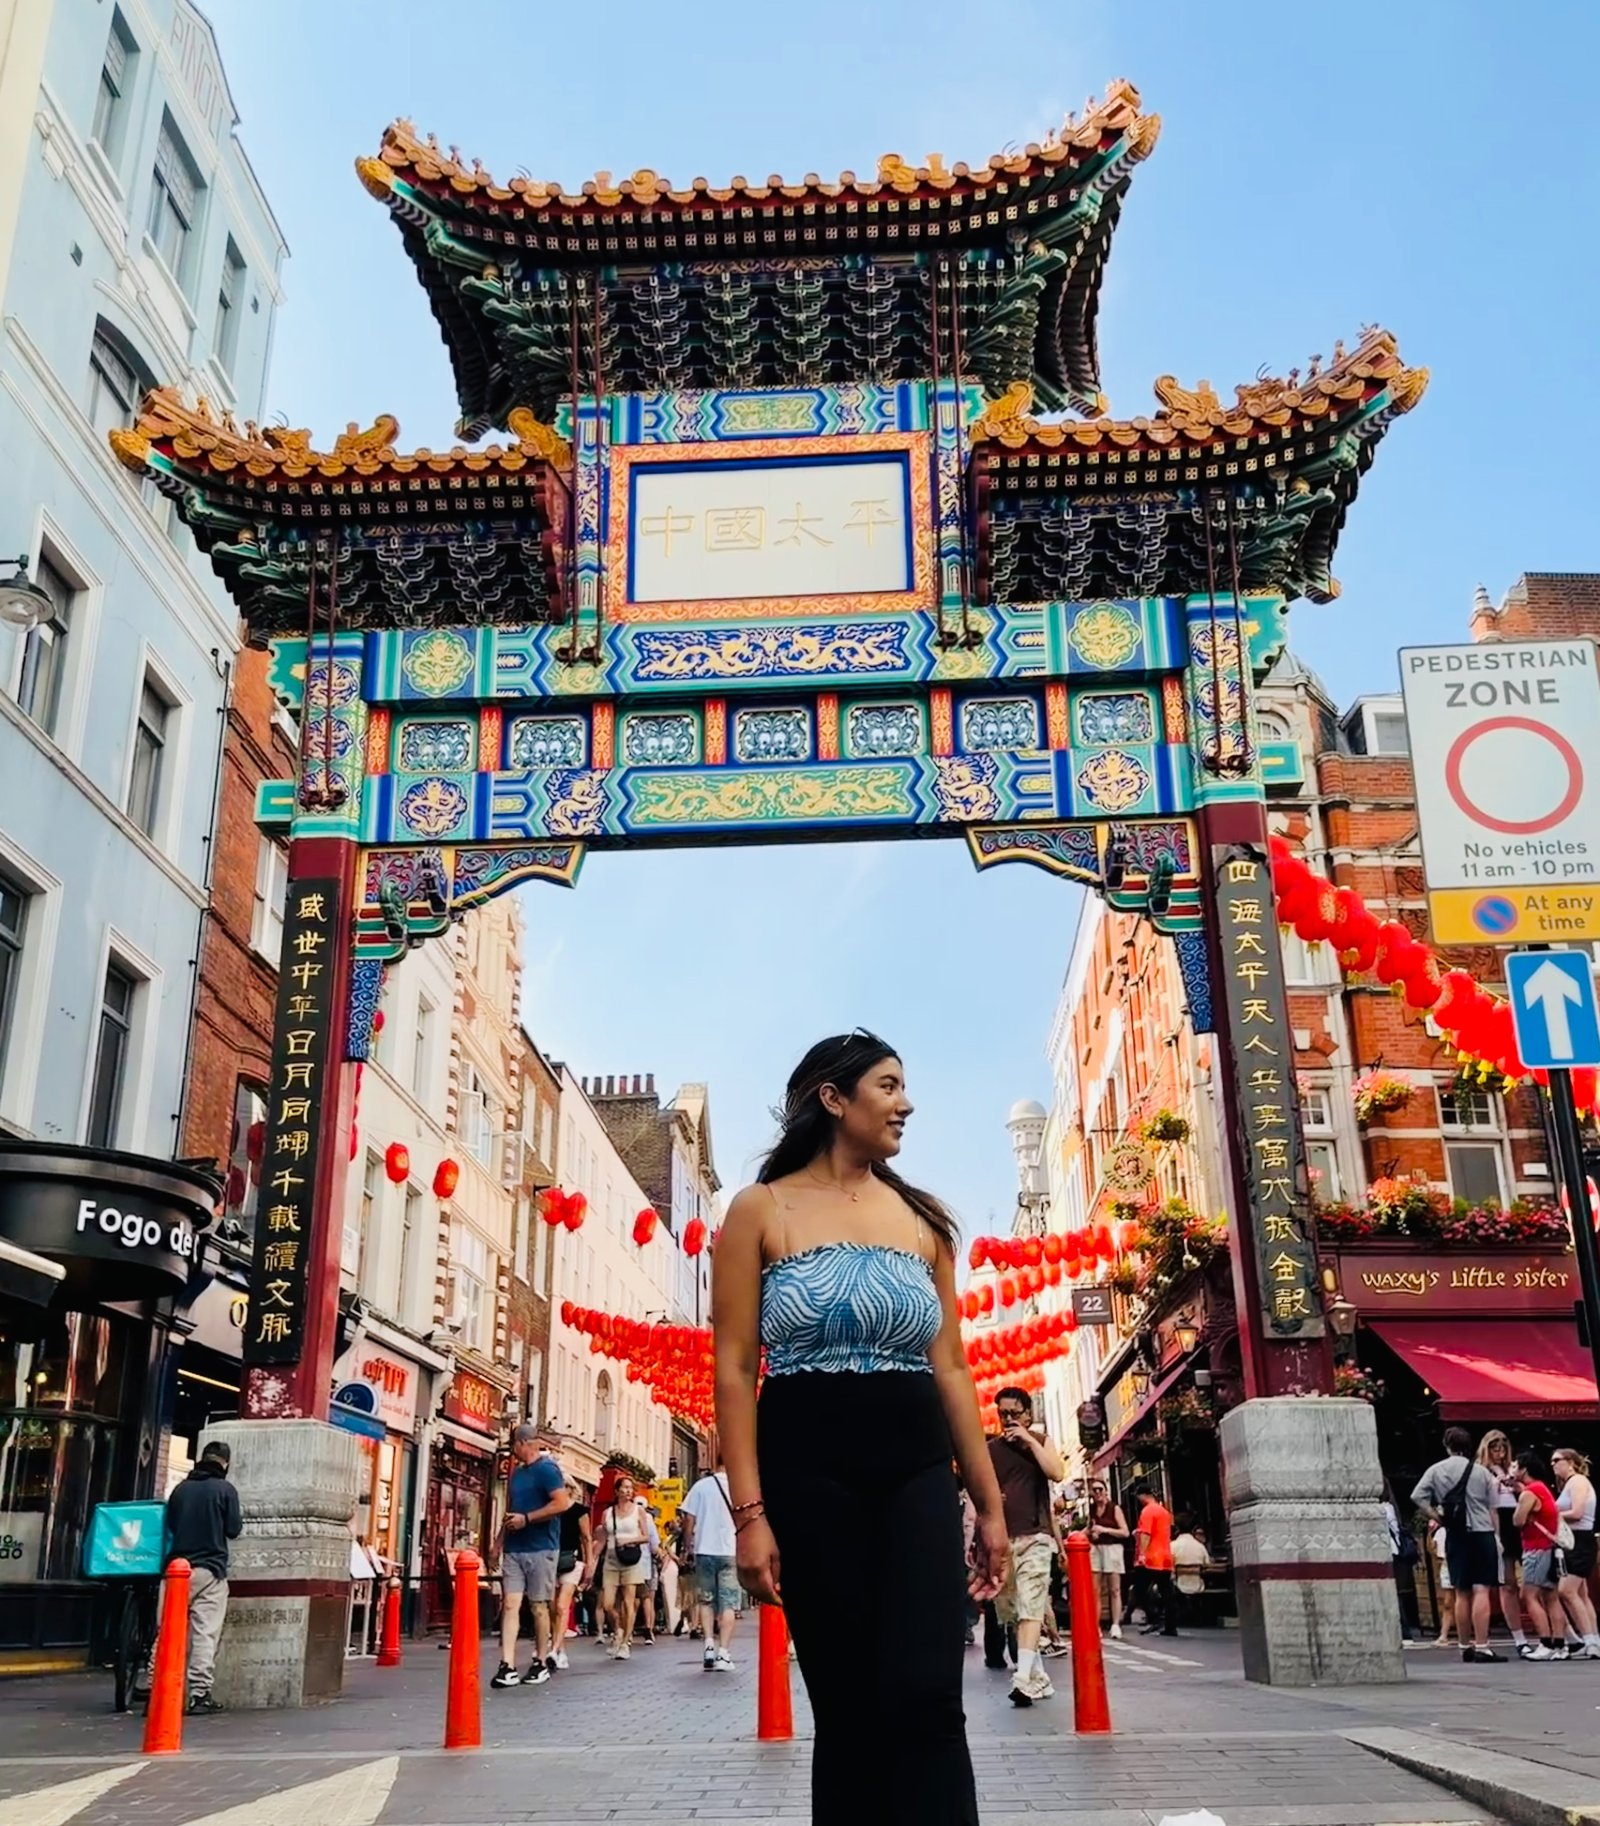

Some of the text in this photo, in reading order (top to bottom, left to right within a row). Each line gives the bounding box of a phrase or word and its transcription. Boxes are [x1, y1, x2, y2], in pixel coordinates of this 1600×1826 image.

[640, 498, 899, 558] 中國太平
[1410, 648, 1588, 674] PEDESTRIAN
[1444, 678, 1560, 708] ZONE
[1463, 840, 1587, 858] No vehicles
[1534, 860, 1558, 876] 10
[1563, 861, 1594, 880] pm
[1524, 895, 1594, 913] At any
[1538, 914, 1586, 931] time
[76, 1199, 162, 1248] Fogo
[169, 1220, 193, 1257] de
[1512, 1266, 1569, 1287] sister
[1081, 1295, 1103, 1311] 22
